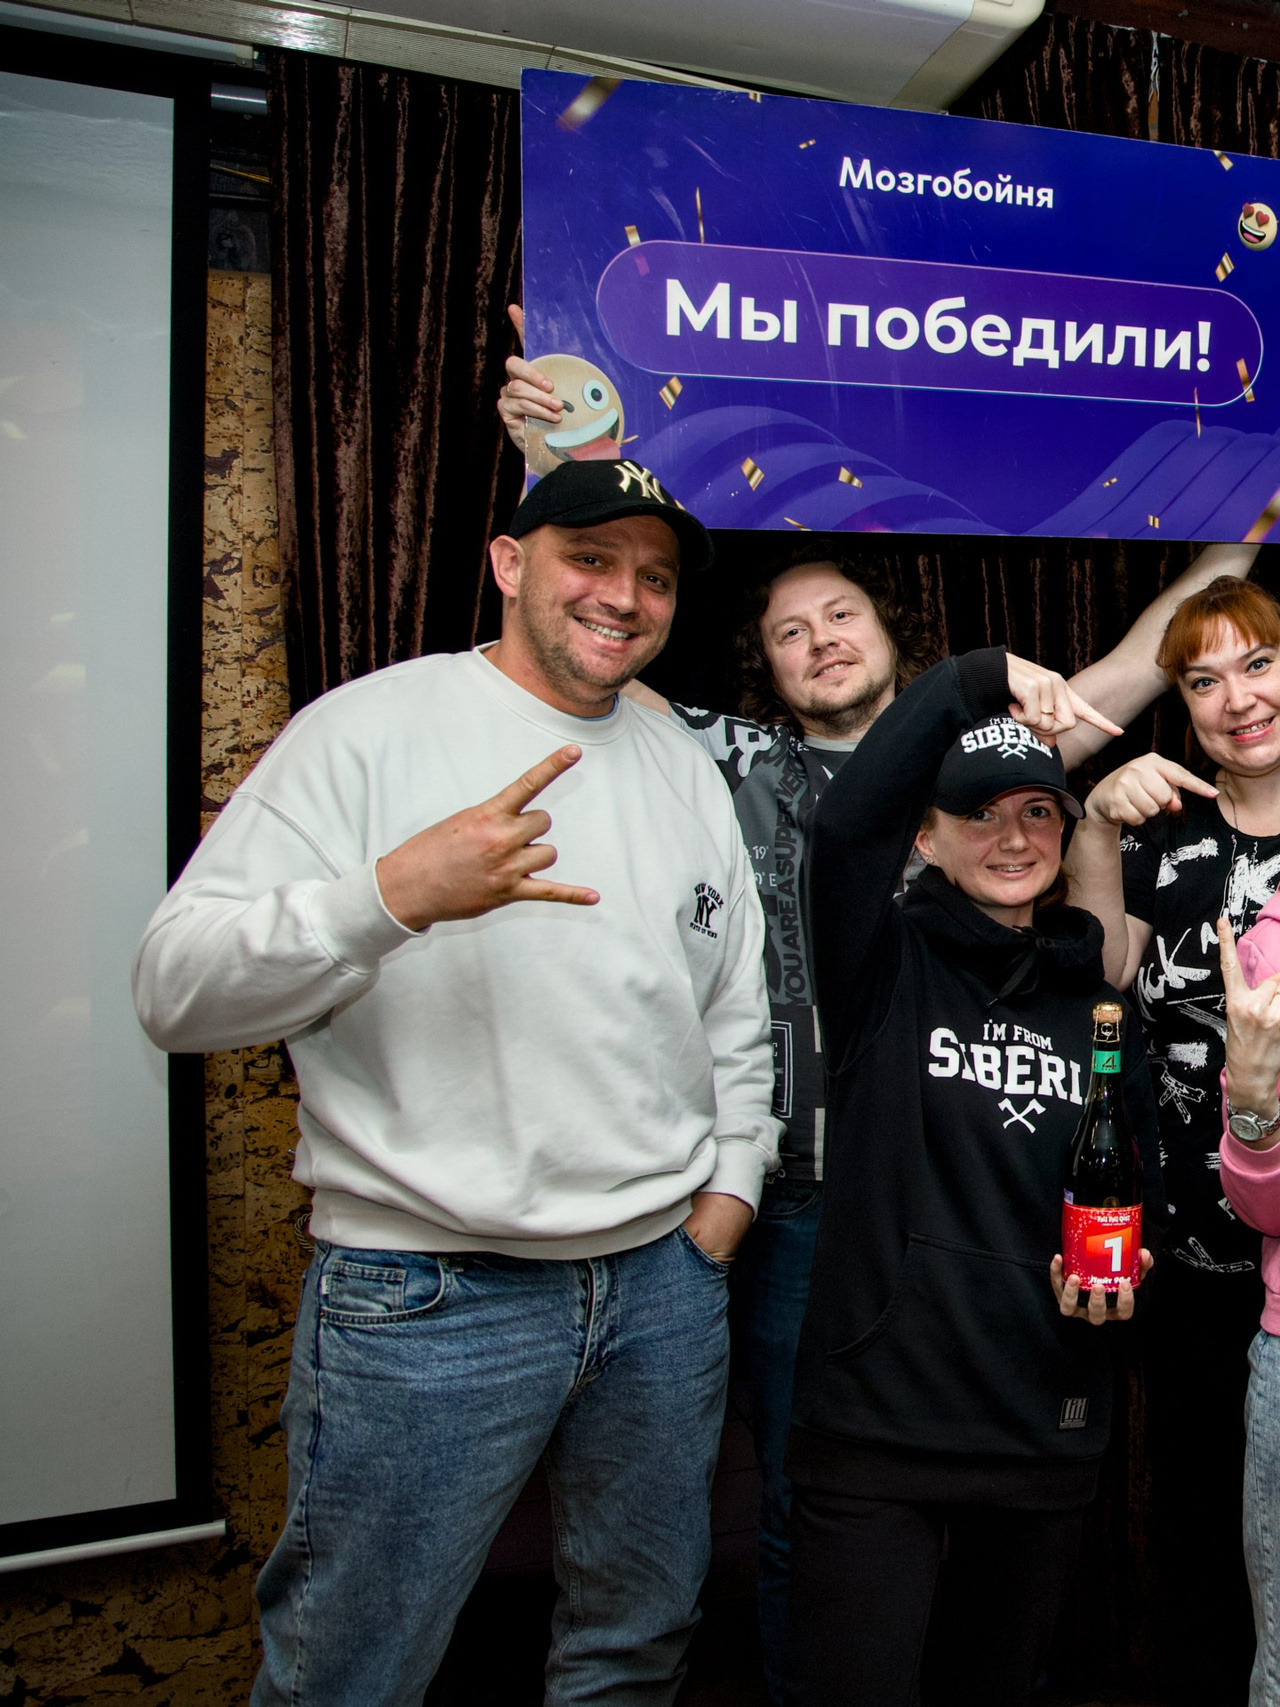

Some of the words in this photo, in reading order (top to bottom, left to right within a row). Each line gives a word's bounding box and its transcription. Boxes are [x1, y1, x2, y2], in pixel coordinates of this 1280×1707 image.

[838, 156, 1055, 210] Мозгобойня
[665, 278, 797, 344] Мы
[827, 296, 1212, 372] победили!
[613, 460, 667, 504] NY
[777, 876, 797, 899] A
[694, 895, 717, 928] NY
[780, 903, 800, 948] ARE
[783, 953, 808, 1006] YOU
[1013, 1024, 1053, 1051] FROM
[928, 1027, 1088, 1106] SIBERI
[1104, 1235, 1122, 1273] 1
